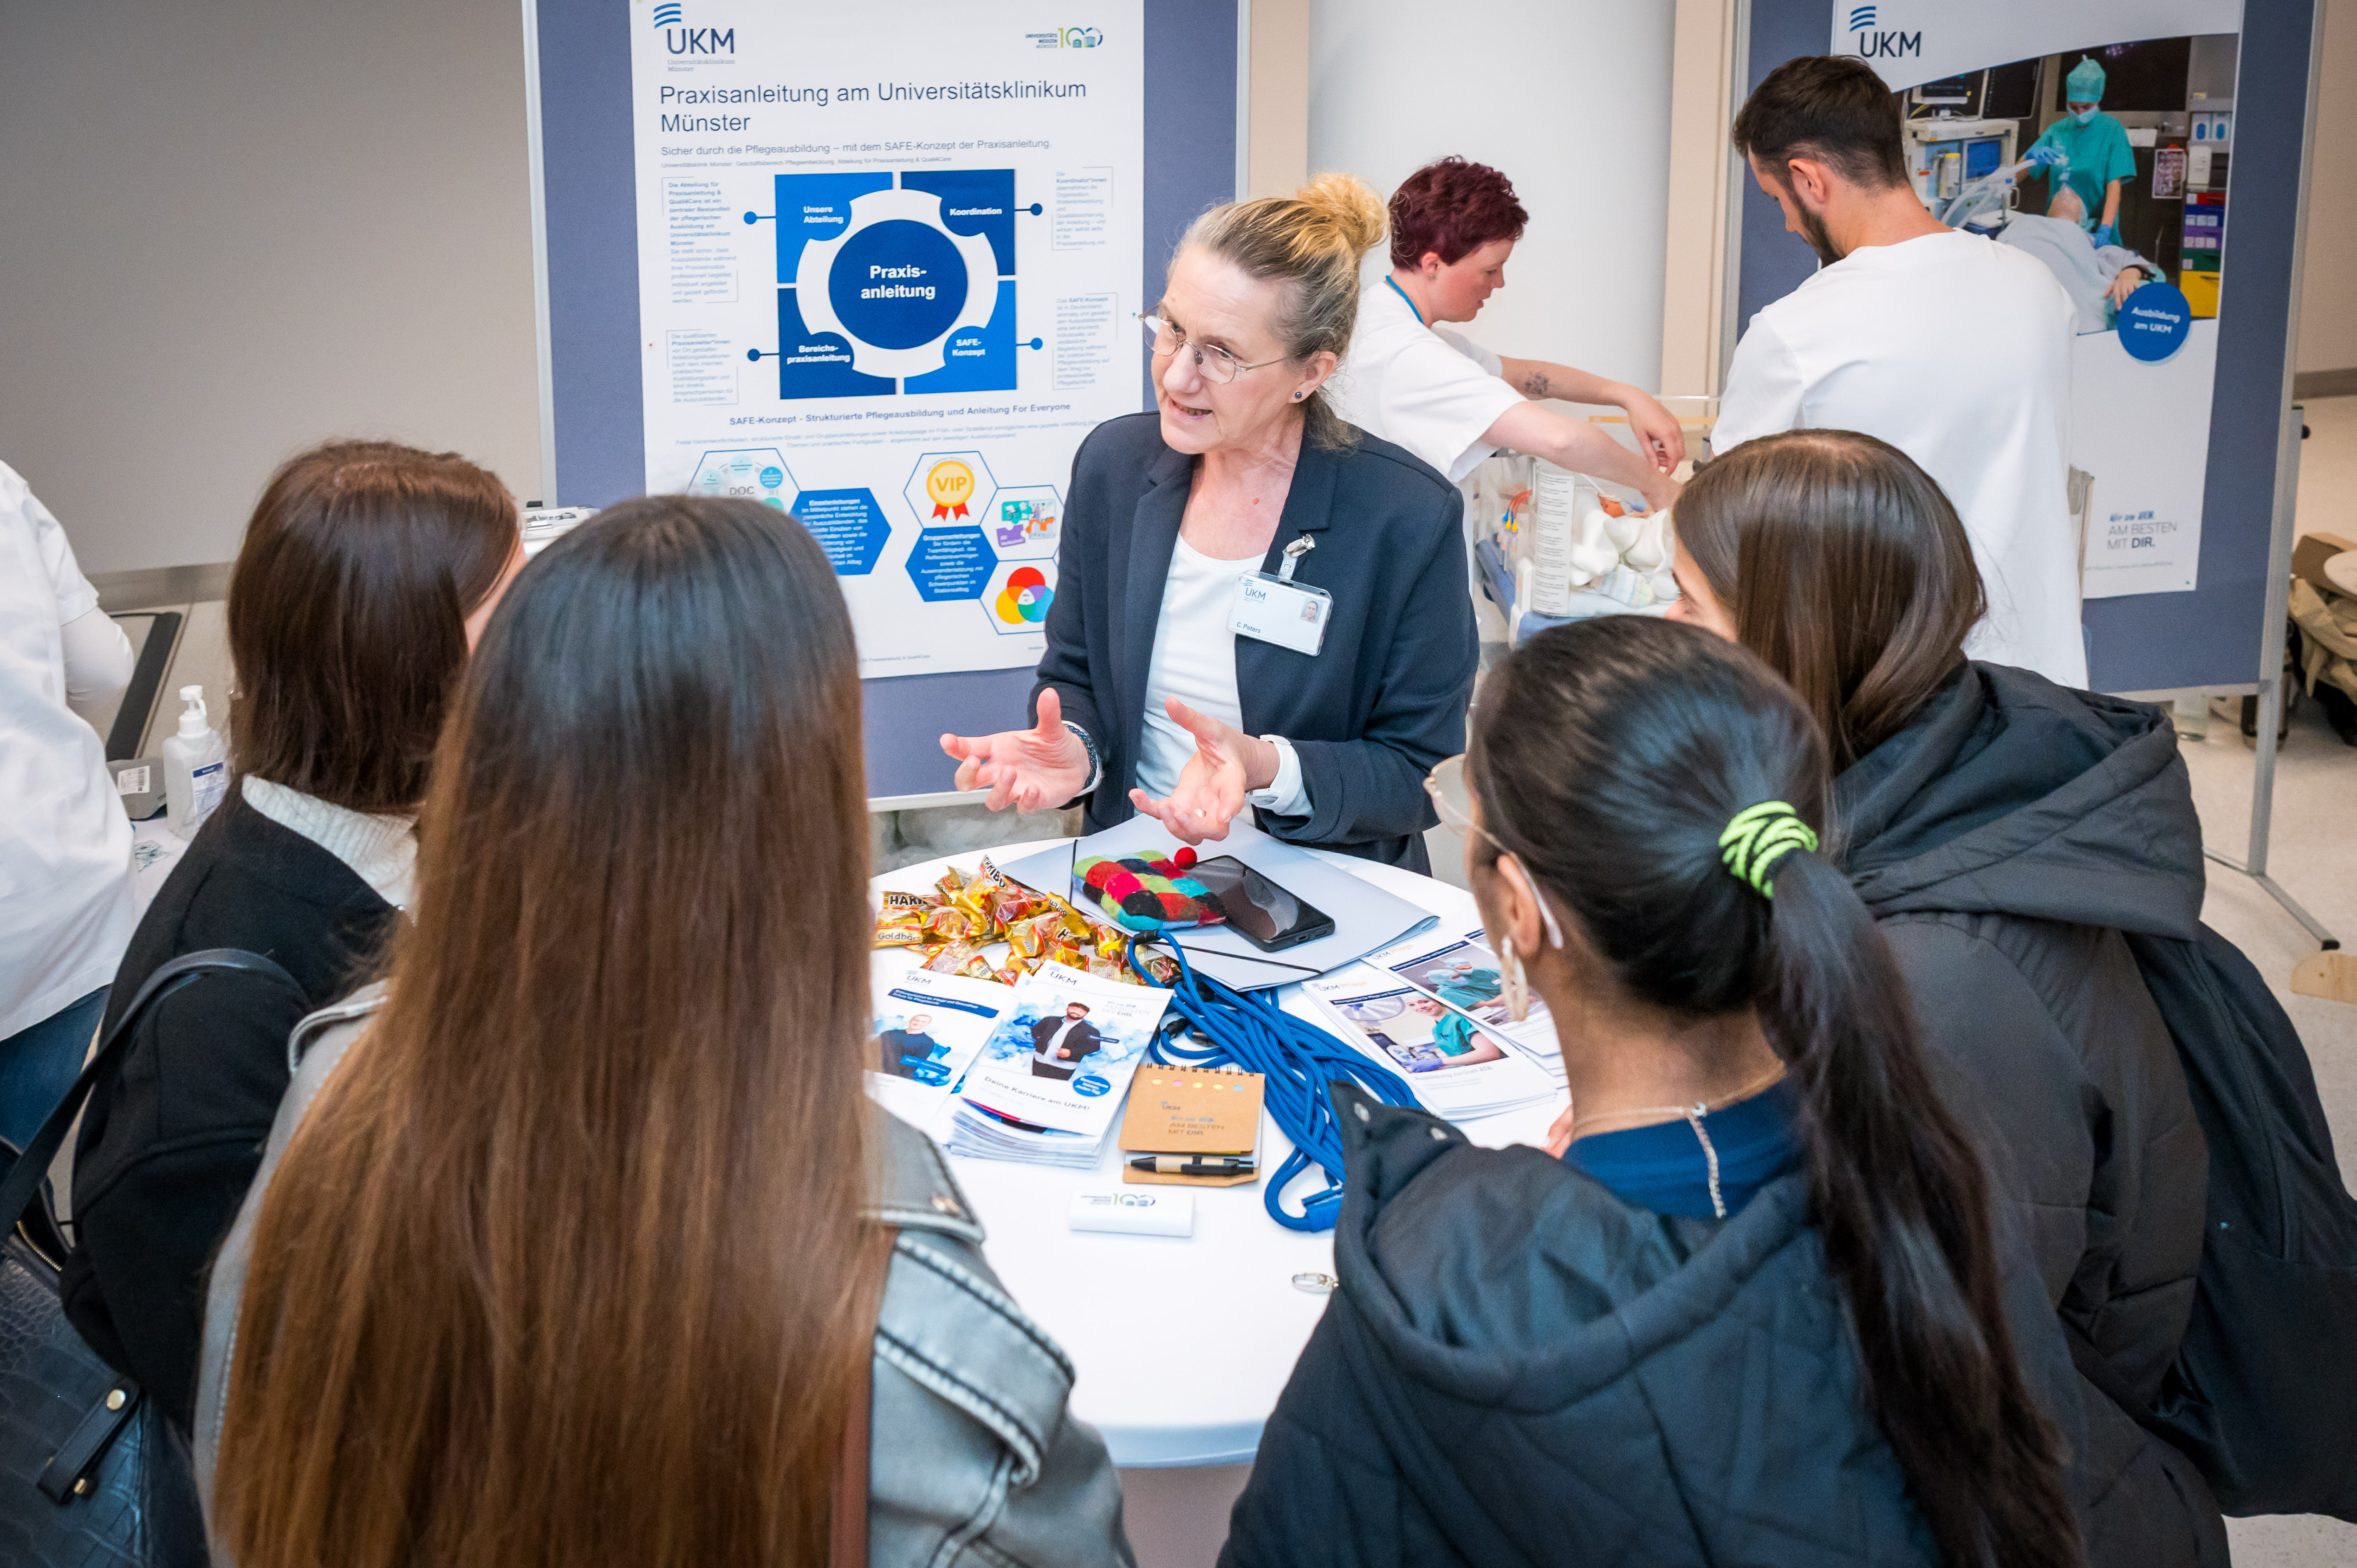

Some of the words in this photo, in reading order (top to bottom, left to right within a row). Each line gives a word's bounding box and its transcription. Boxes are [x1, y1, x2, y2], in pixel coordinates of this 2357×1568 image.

[667, 28, 734, 54] UKM
[1860, 32, 1921, 58] UKM
[661, 84, 829, 107] Praxisanleitung
[837, 87, 870, 102] am
[878, 79, 1086, 101] Universitätsklinikum
[661, 113, 751, 133] Münster
[661, 146, 692, 156] Sicher
[696, 146, 724, 155] durch
[727, 146, 742, 154] die
[746, 144, 830, 155] Pflegeausbildung
[843, 143, 857, 152] mit
[860, 143, 881, 152] dem
[884, 141, 955, 151] SAFE-Konzept
[959, 141, 974, 149] der
[977, 139, 1052, 149] Praxisanleitung.
[803, 205, 833, 214] Unsere
[949, 207, 1002, 216] Koordination
[804, 214, 844, 224] Abteilung
[870, 265, 927, 279] Praxis-
[861, 285, 935, 300] anleitung
[2131, 307, 2180, 324] Ausbildung
[2149, 323, 2172, 333] UKM
[799, 344, 838, 353] Bereichs-
[956, 338, 981, 347] SAFE-
[787, 353, 851, 365] praxisanleitung
[952, 348, 986, 357] Konzept
[729, 415, 797, 425] SAFE-Konzept
[805, 412, 863, 421] Strukturierte
[866, 409, 944, 420] Pflegeausbildung
[967, 406, 1009, 416] Anleitung
[1013, 405, 1027, 413] For
[1030, 403, 1071, 414] Everyone
[729, 486, 754, 495] DOC
[935, 476, 967, 492] VIP
[2109, 525, 2128, 535] AM
[2131, 522, 2177, 534] BESTEN
[2107, 538, 2128, 550] MIT
[2132, 537, 2156, 548] DIR.
[1246, 587, 1266, 600] UKM
[1243, 623, 1261, 634] Peters
[1371, 951, 1392, 960] UKM
[907, 975, 932, 985] UKM
[1050, 972, 1077, 985] UKM
[984, 1076, 1009, 1089] Deine
[1011, 1087, 1045, 1101] Karriere
[1064, 1101, 1090, 1111] UKM!
